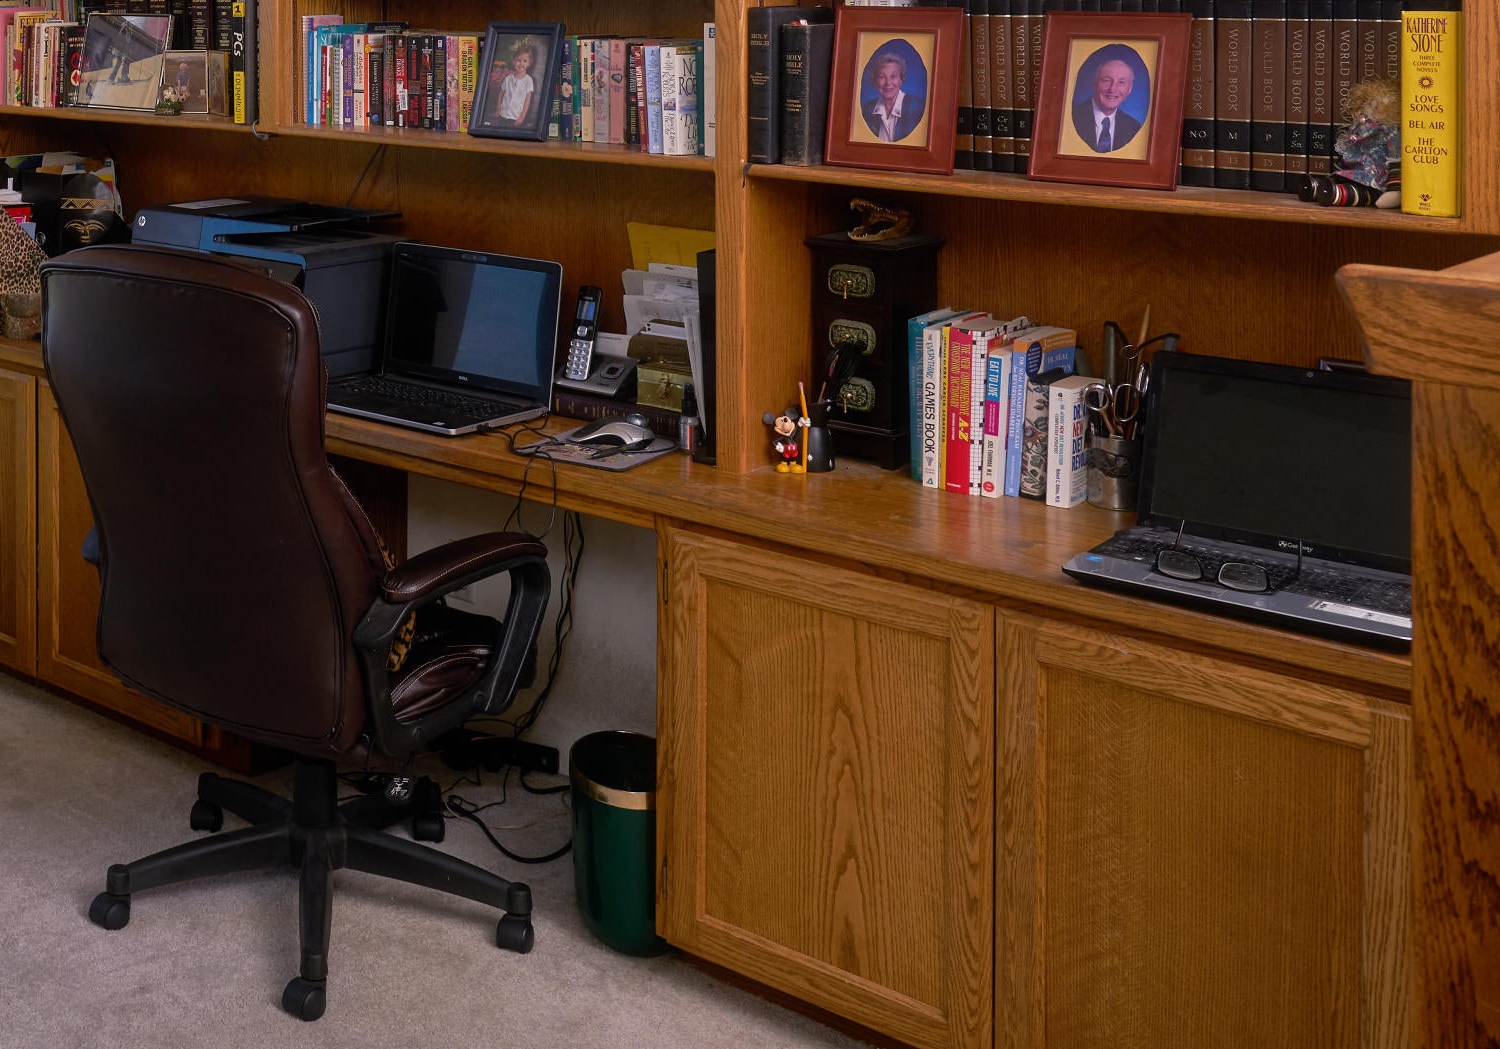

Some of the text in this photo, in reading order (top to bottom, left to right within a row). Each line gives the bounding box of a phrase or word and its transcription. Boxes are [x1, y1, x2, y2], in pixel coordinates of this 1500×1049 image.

[1406, 17, 1448, 34] KATHERINE
[233, 31, 243, 57] PCs
[1340, 30, 1350, 76] WORLD
[1364, 30, 1375, 77] WORLD
[1387, 31, 1398, 78] WORLD
[1411, 34, 1444, 53] STONE
[996, 24, 1006, 101] WORLD BOOK
[1016, 25, 1026, 102] WORLD BOOK
[1228, 28, 1239, 112] WORLD BOOK
[1292, 30, 1303, 113] WORLD BOOK
[1315, 30, 1325, 115] WORLD BOOK
[1410, 104, 1444, 113] SONGS
[1414, 95, 1439, 103] LOVE
[1228, 132, 1238, 140] M
[1409, 120, 1445, 130] BEL AIR
[1405, 145, 1448, 156] CARLTON
[1418, 137, 1435, 146] THE
[1413, 155, 1439, 165] CLUB
[988, 361, 999, 397] EAT TO LIVE
[925, 382, 935, 420] GAMES
[924, 423, 935, 454] BOOK
[958, 417, 969, 442] A-Z
